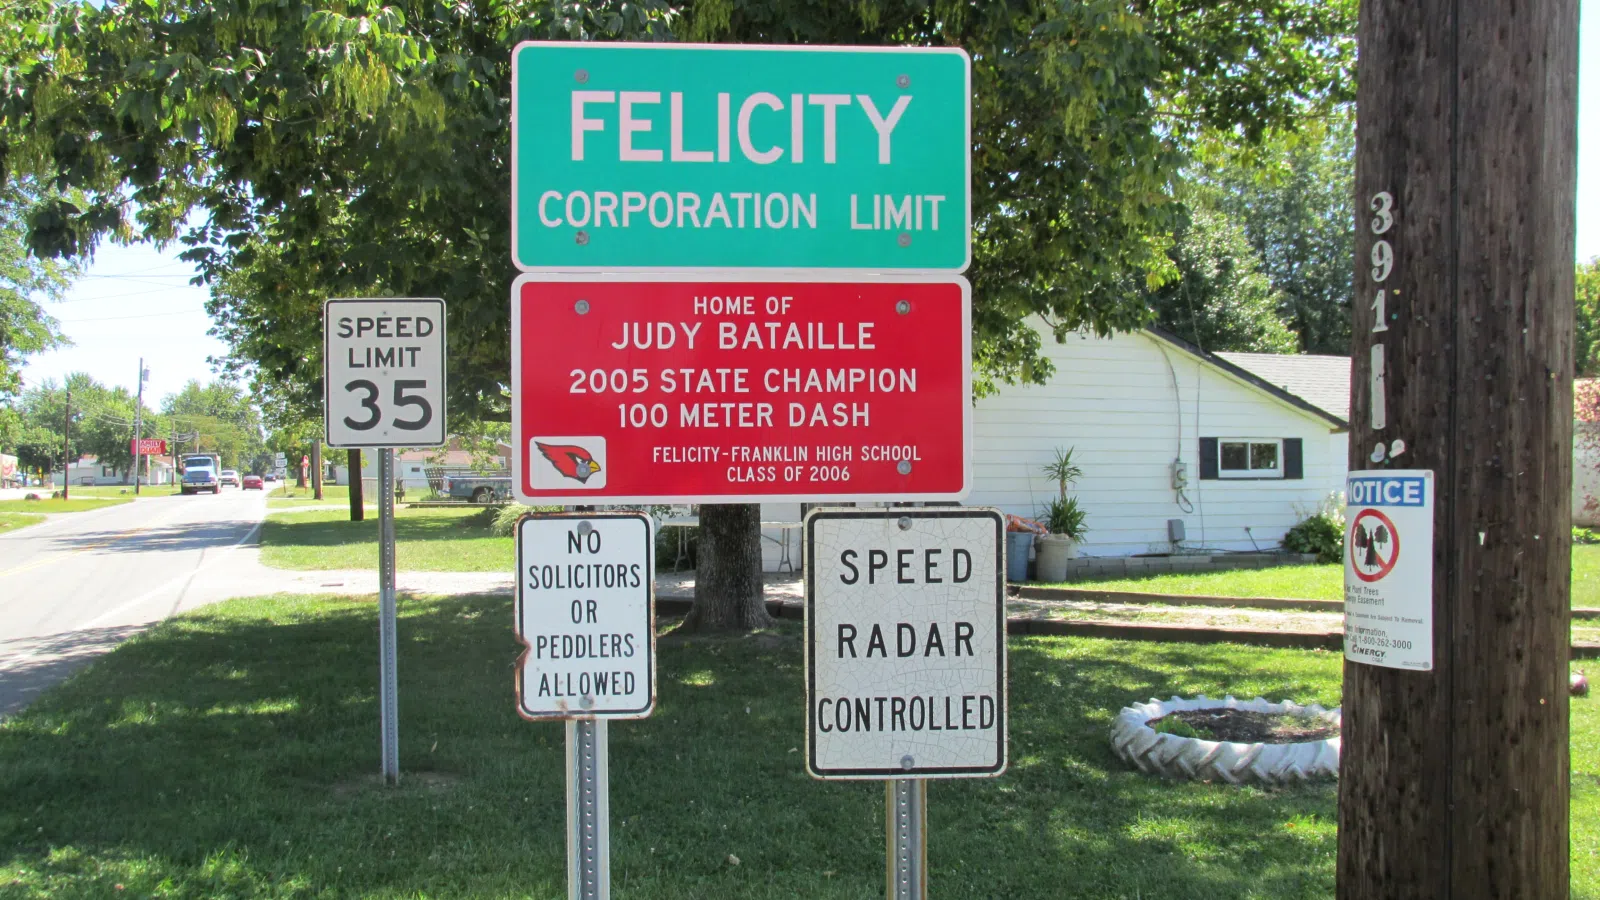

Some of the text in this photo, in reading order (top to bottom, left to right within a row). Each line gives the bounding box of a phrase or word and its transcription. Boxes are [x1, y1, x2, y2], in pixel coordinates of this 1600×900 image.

[571, 90, 913, 165] FELICITY
[538, 190, 946, 230] CORPORATION LIMIT
[694, 296, 794, 315] HOME OF
[336, 316, 434, 339] SPEED
[611, 322, 876, 350] JUDY BATAILLE
[348, 346, 422, 368] LIMIT
[569, 368, 917, 394] 2005 STATE CHAMPION
[343, 379, 433, 431] 35
[618, 402, 870, 428] 100 METER DASH
[652, 445, 922, 463] FELICITY-FRANKLIN HIGH SCHOOL
[727, 465, 850, 483] CLASS OF 2006
[567, 529, 602, 554] NO
[529, 563, 641, 590] SOLICITORS
[839, 548, 972, 586] SPEED
[1357, 595, 1385, 606] Easement
[1364, 586, 1379, 596] Trees
[571, 599, 598, 624] OR
[1401, 617, 1424, 625] Removal.
[536, 633, 634, 659] PEDDLERS
[837, 621, 975, 659] RADAR
[1352, 644, 1386, 658] CINERGY
[1358, 636, 1412, 650] 1-800-262-3000
[538, 671, 635, 698] ALLOWED
[818, 694, 995, 733] CONTROLLED
